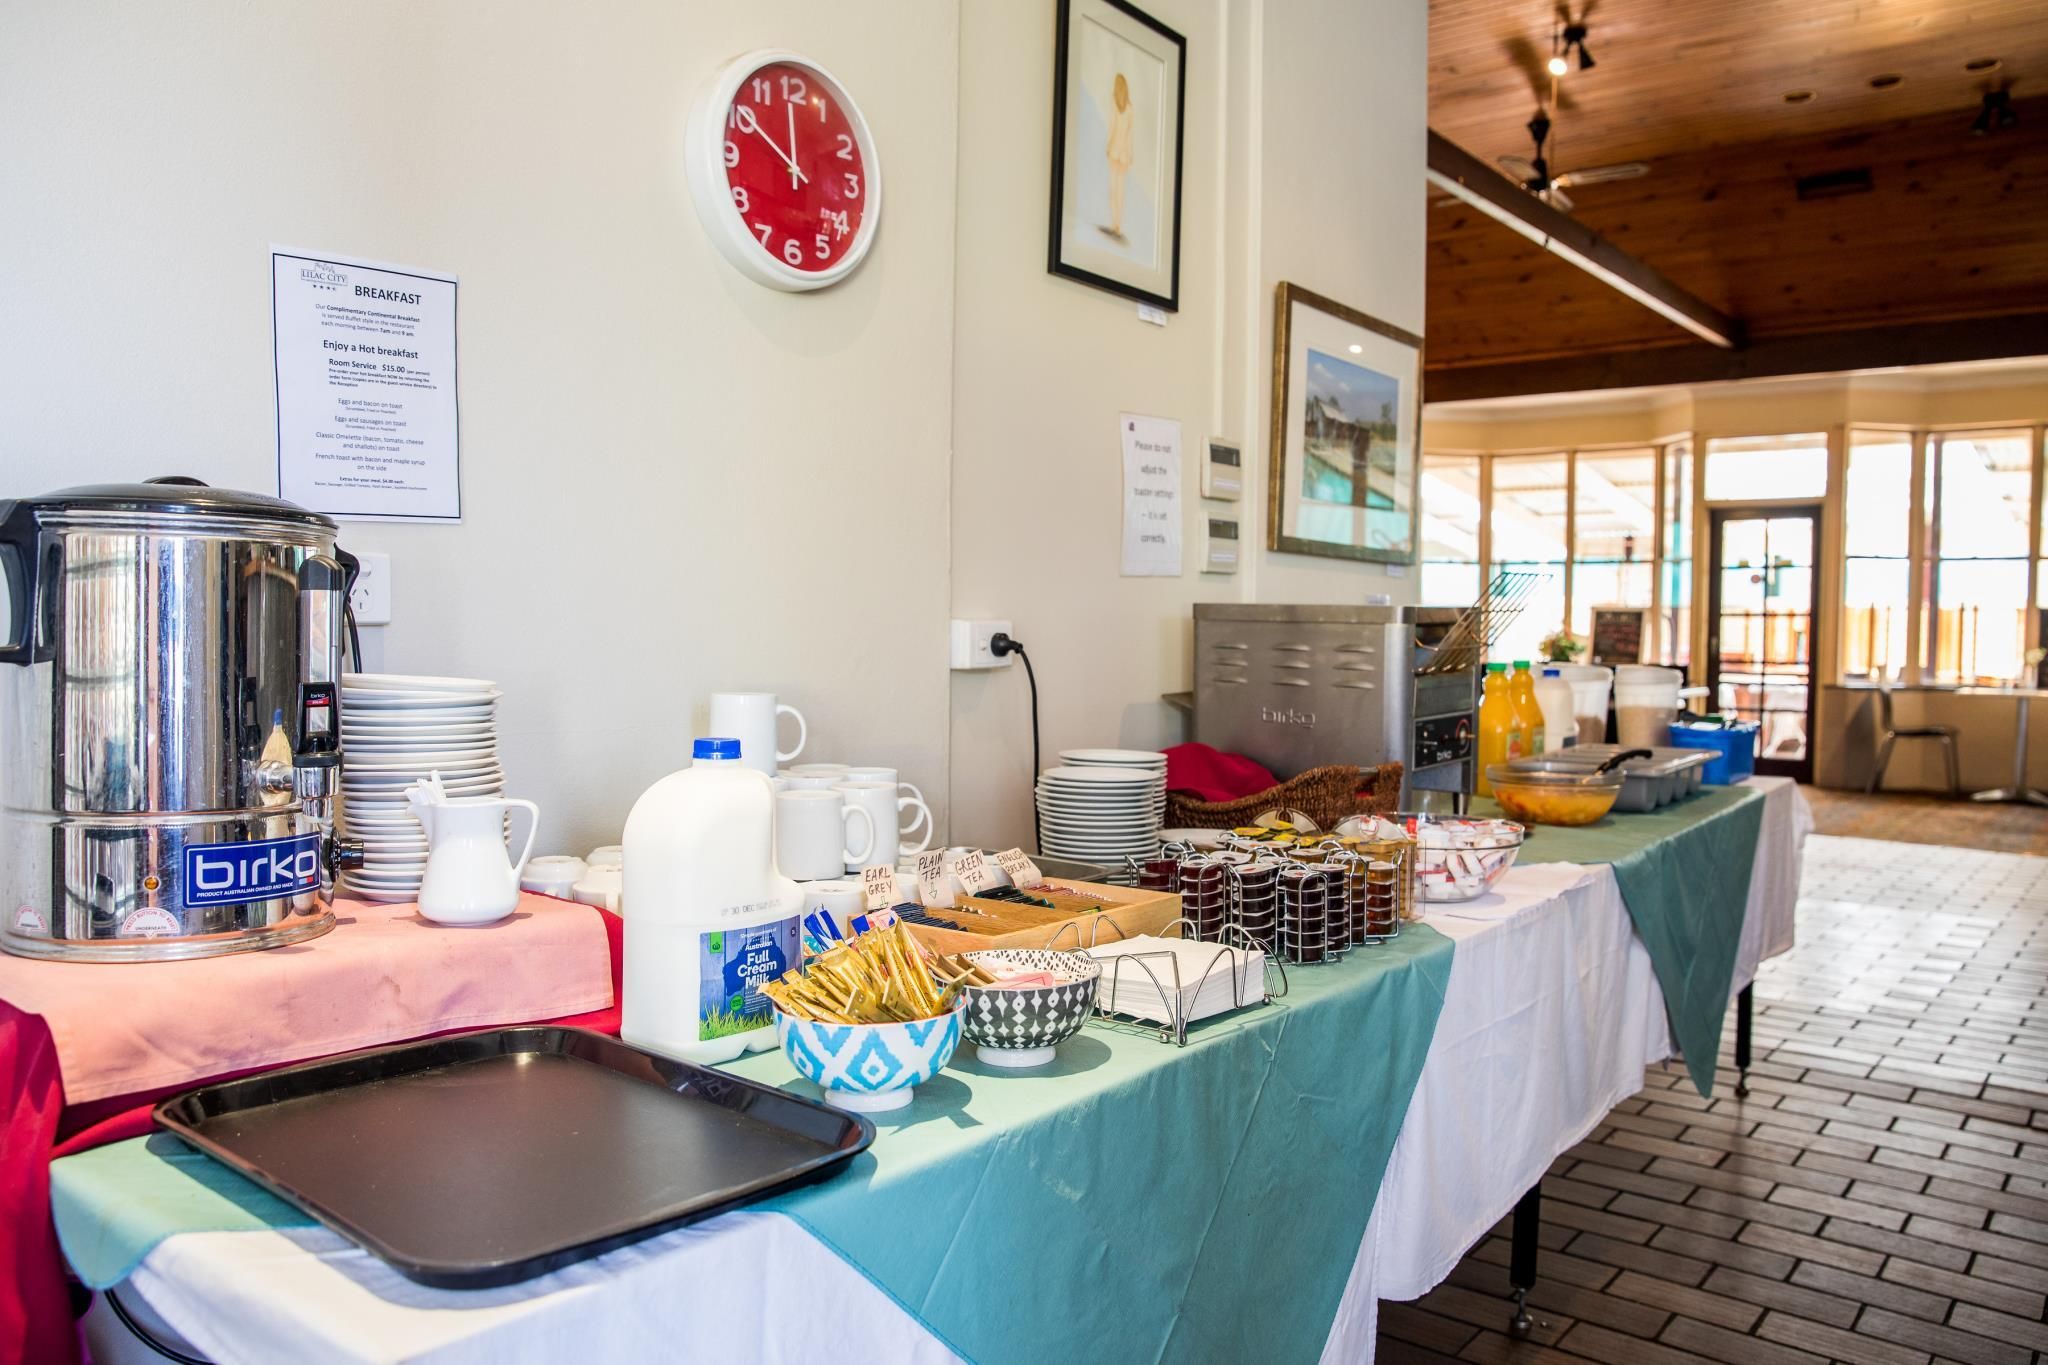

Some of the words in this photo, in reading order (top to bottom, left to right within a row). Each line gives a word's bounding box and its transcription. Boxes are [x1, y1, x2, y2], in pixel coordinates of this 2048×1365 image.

[753, 78, 770, 105] 11
[780, 76, 806, 105] 12
[729, 104, 756, 133] 10
[818, 99, 826, 123] 1
[724, 141, 739, 168] 9
[837, 134, 853, 160] 2
[844, 173, 859, 198] 3
[732, 186, 750, 213] 8
[834, 210, 850, 234] 4
[755, 223, 772, 248] 7
[784, 239, 802, 265] 6
[816, 234, 830, 259] 5
[302, 270, 325, 280] LILAC
[328, 273, 346, 282] CITY
[355, 285, 422, 305] BREAKFAST
[326, 304, 366, 316] Complimentary
[368, 309, 396, 319] Continental
[398, 314, 420, 323] Breakfast
[334, 322, 356, 330] morning
[357, 324, 379, 333] between
[362, 316, 374, 325] style
[390, 322, 415, 330] restaurant
[323, 339, 349, 352] Enjoy
[359, 344, 375, 354] Hot
[378, 346, 418, 359] breakfast
[329, 358, 350, 367] Room
[352, 360, 377, 370] Service
[382, 364, 405, 373] $15.00
[338, 398, 351, 406] Eggs
[335, 415, 348, 423] Eggs
[360, 418, 384, 426] sausages
[316, 432, 335, 440] Classic
[336, 433, 362, 441] Omelette
[354, 443, 377, 451] shallots)
[394, 458, 410, 466] maple
[1262, 706, 1316, 725] birko
[196, 848, 316, 890] birko
[918, 850, 945, 871] PLAIN
[955, 854, 983, 875] GREEN
[866, 867, 890, 882] EARL
[922, 866, 941, 882] TEA
[964, 871, 985, 884] TEA
[197, 890, 223, 898] PRODUCT
[224, 887, 254, 895] AUSTRALIAN
[868, 883, 892, 896] GREY
[745, 941, 772, 951] Australian
[747, 950, 769, 965] Full
[737, 961, 777, 977] Cream
[745, 974, 770, 989] Milk
